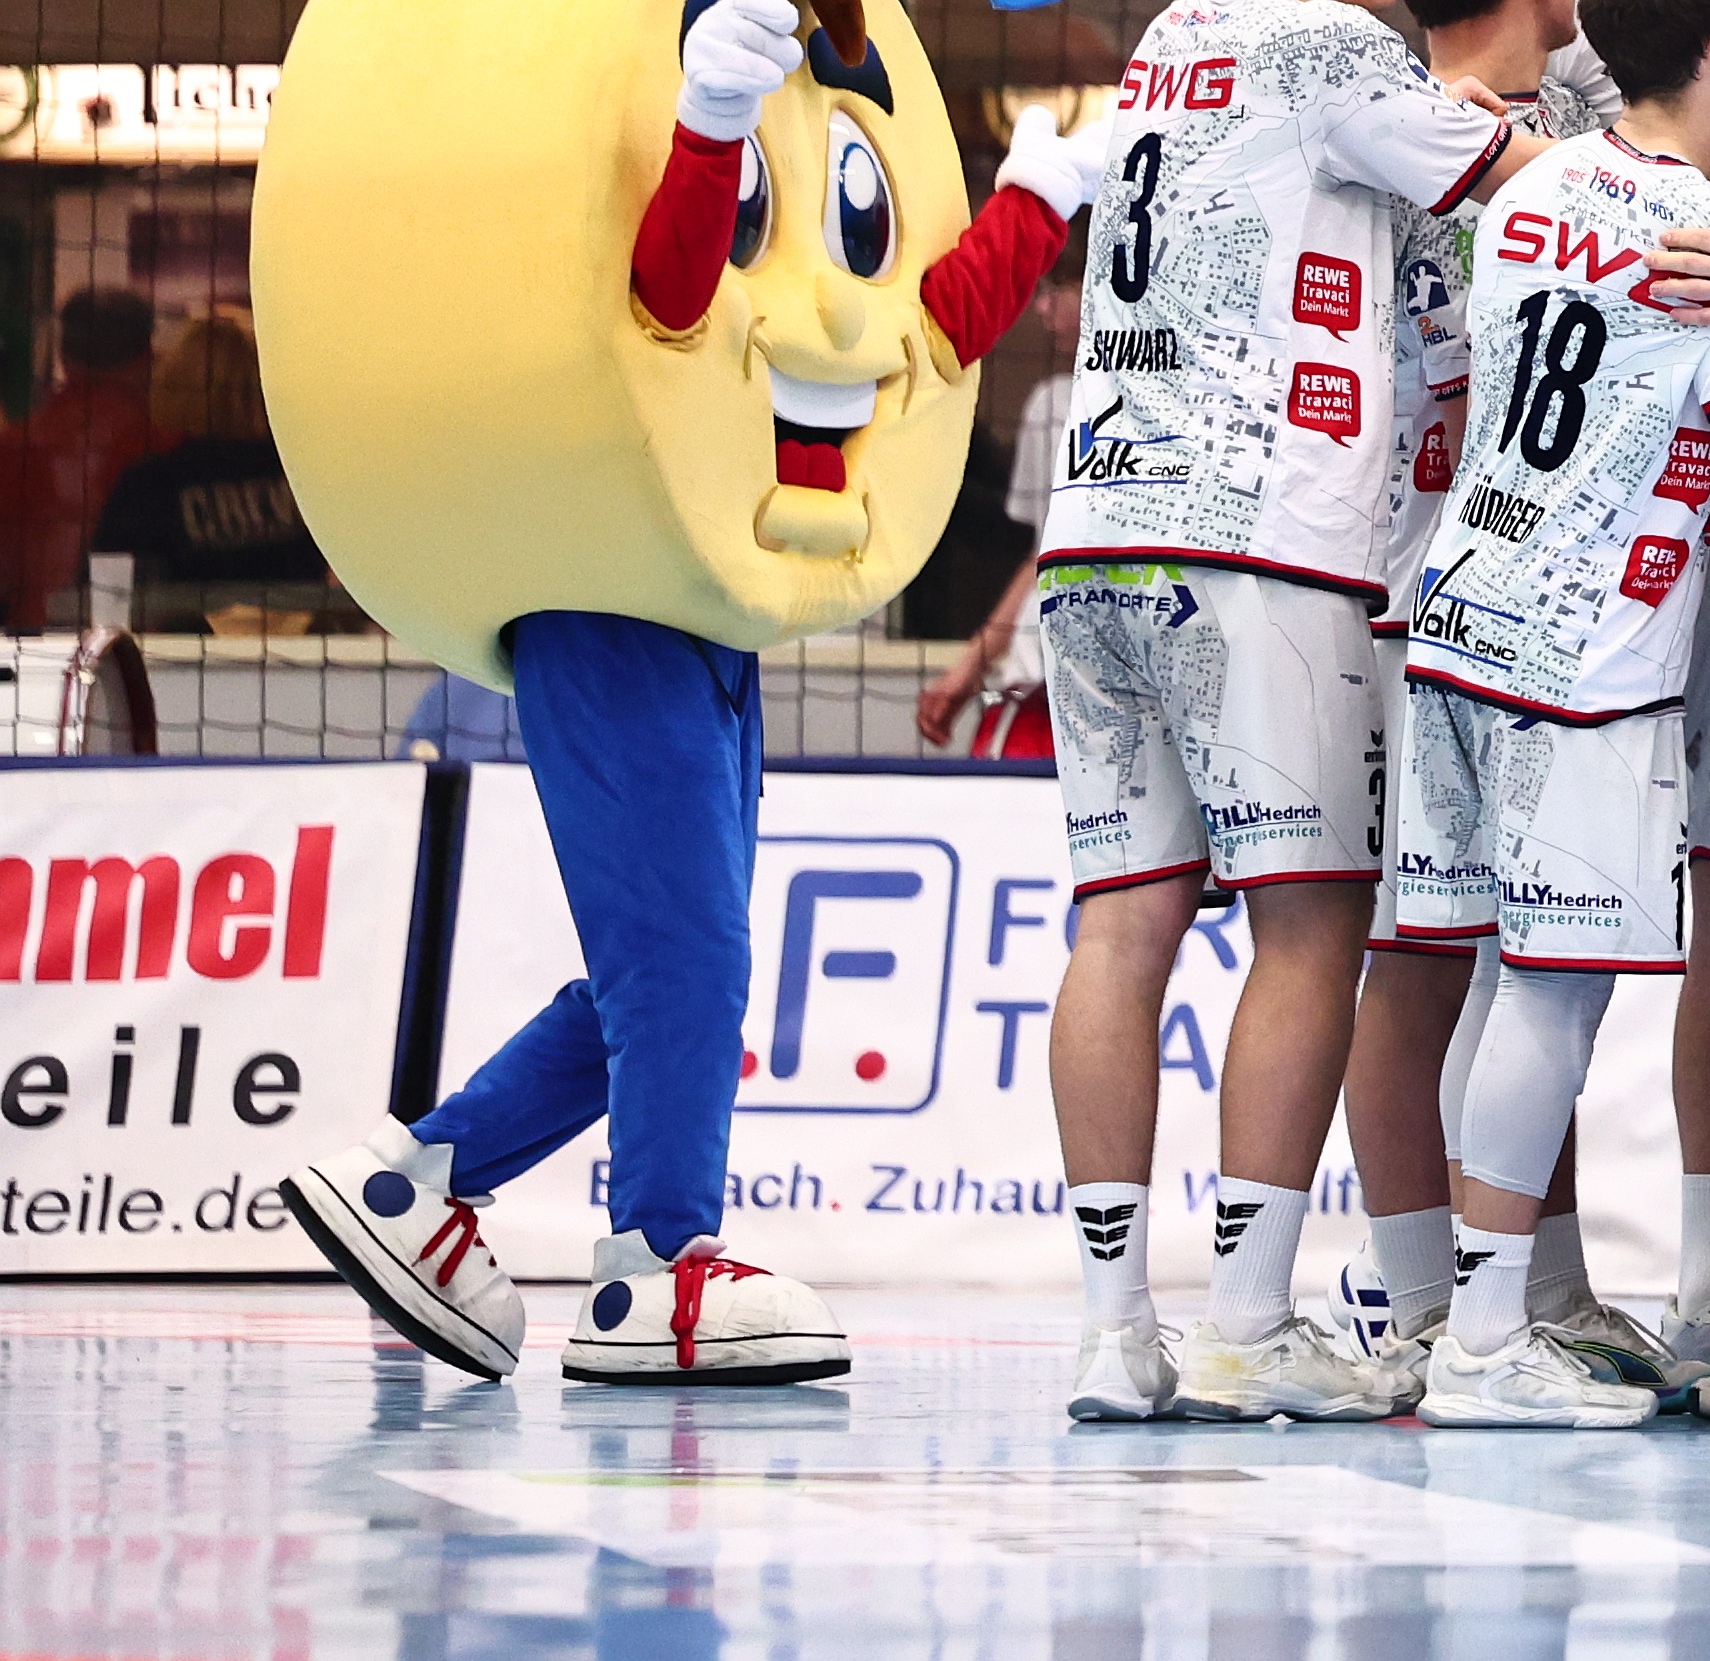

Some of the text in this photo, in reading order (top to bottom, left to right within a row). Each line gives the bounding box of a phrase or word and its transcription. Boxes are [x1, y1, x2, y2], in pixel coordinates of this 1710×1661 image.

[1118, 57, 1237, 111] SWG
[1561, 167, 1586, 184] 1905
[1588, 166, 1637, 205] 1969
[1109, 132, 1162, 303] 3
[1304, 264, 1350, 288] REWE
[1300, 299, 1349, 318] Dein Markt
[1302, 283, 1350, 304] Travaci
[1300, 373, 1352, 395] REWE
[1498, 289, 1607, 472] 18
[1298, 392, 1353, 410] Travaci
[1298, 407, 1321, 421] Dein
[1068, 395, 1191, 481] Volk CNC
[1413, 548, 1517, 662] Volk CNC
